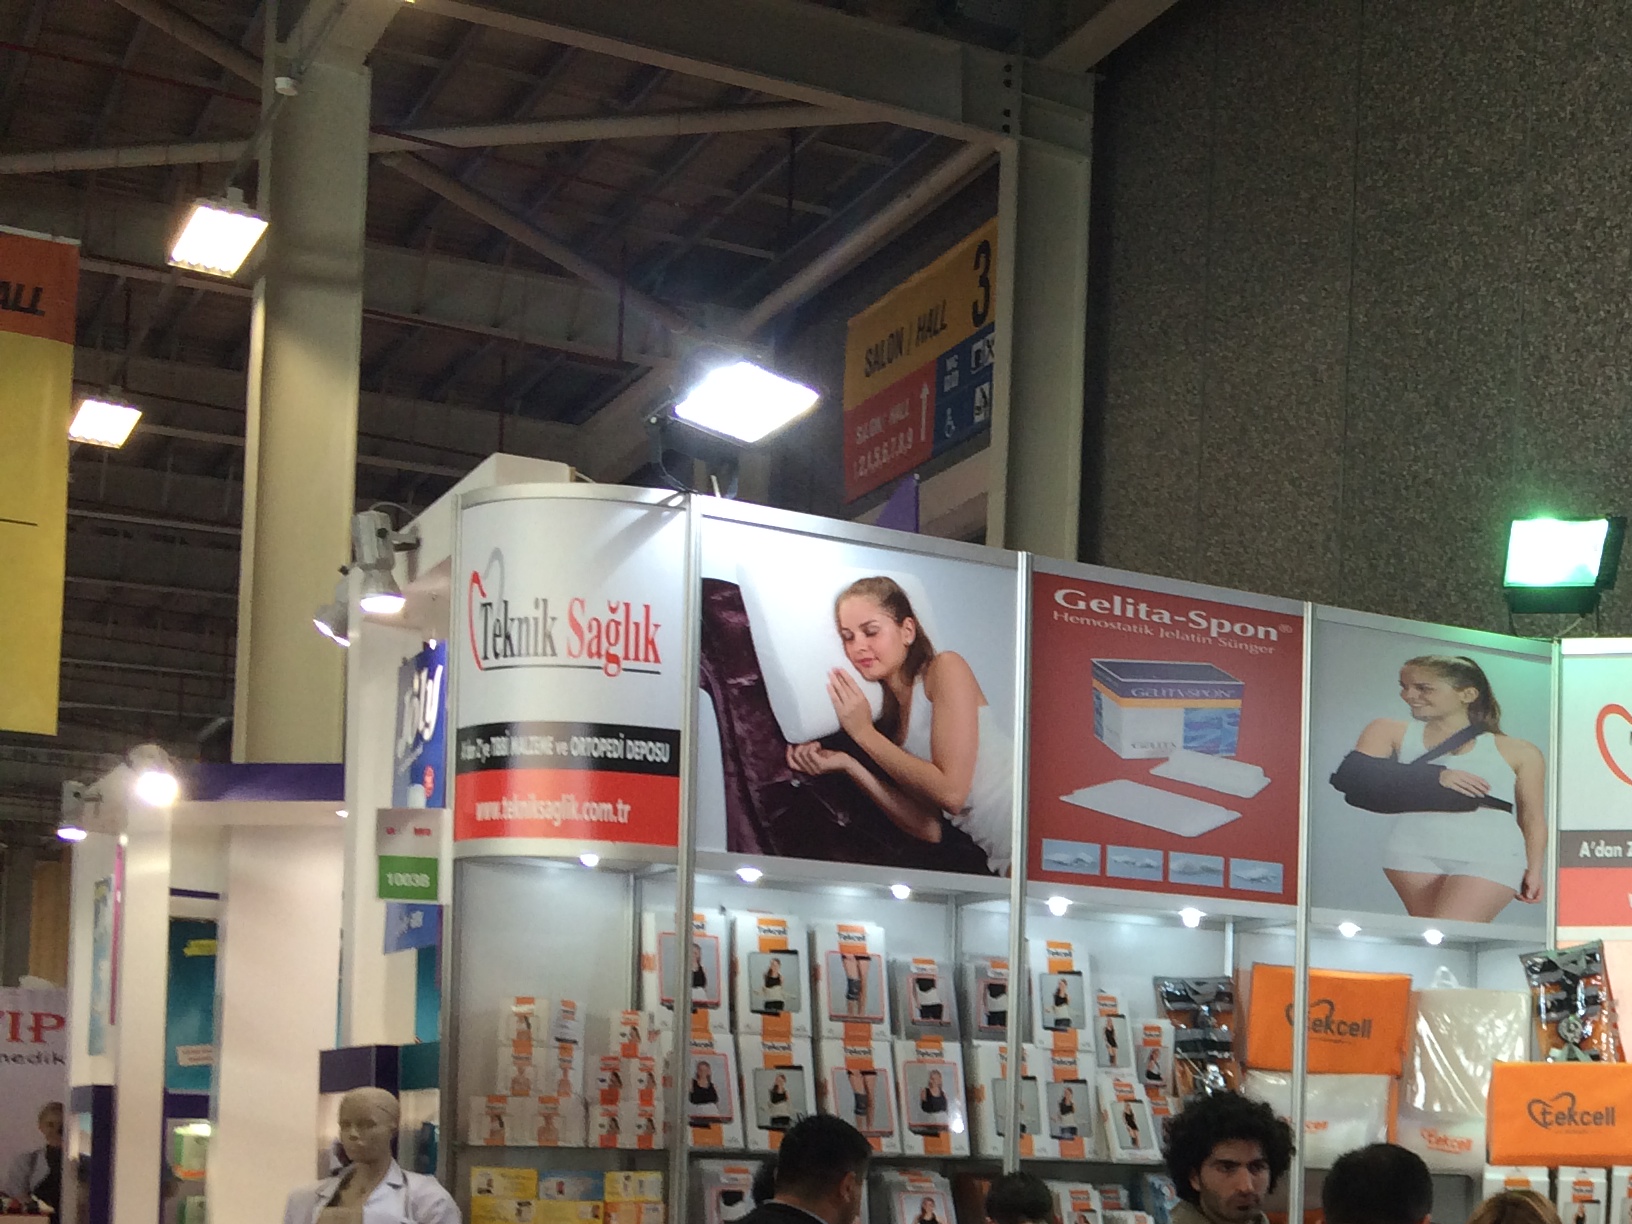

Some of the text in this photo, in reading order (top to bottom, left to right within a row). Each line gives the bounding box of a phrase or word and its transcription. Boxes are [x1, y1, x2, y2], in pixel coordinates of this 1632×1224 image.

[972, 240, 990, 328] 3
[864, 299, 948, 378] SALON HALL
[480, 598, 662, 677] Teknik Sağlık
[1053, 610, 1154, 636] Hemostatik
[1159, 627, 1214, 646] Jelatin
[626, 738, 670, 763] DEPOSU
[1578, 840, 1623, 859] A'dan
[0, 1010, 66, 1043] IP
[1307, 1016, 1372, 1040] ekcell
[1541, 1106, 1616, 1127] tekcell
